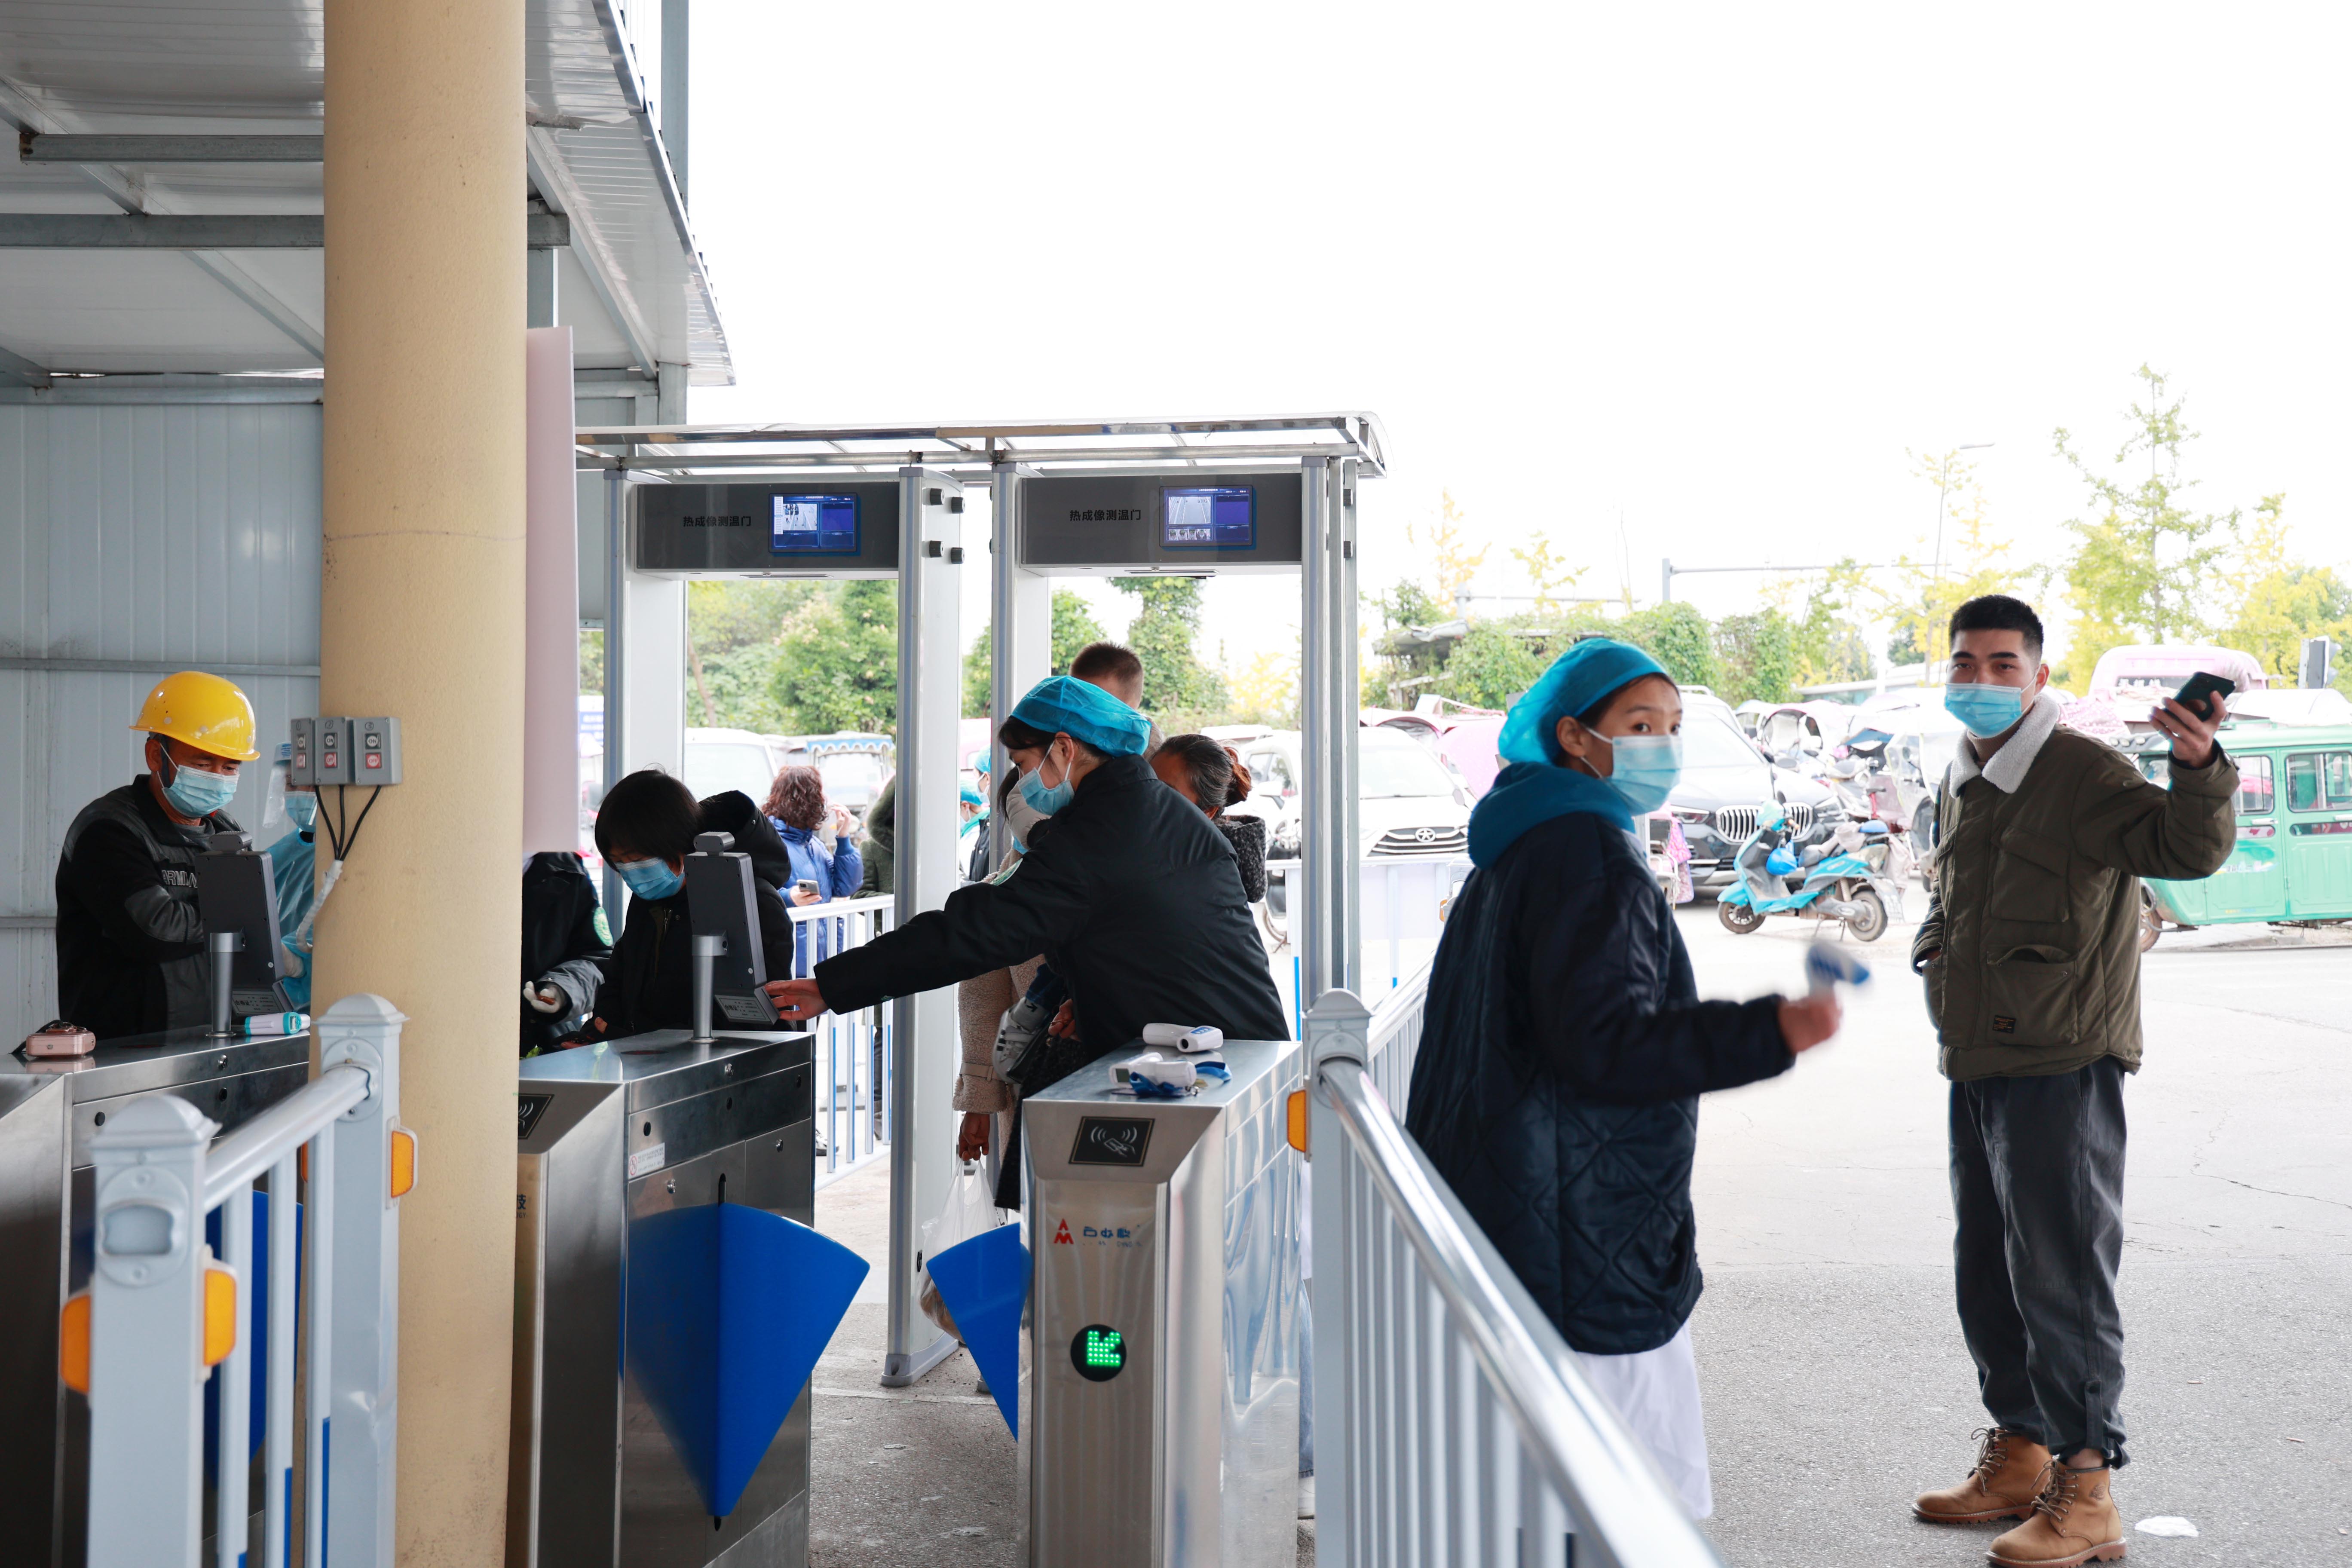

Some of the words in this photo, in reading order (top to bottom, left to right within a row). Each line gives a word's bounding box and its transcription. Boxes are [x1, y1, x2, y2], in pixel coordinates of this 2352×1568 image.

[1069, 509, 1141, 521] 热成像测温门
[683, 516, 752, 527] 热成像测温门
